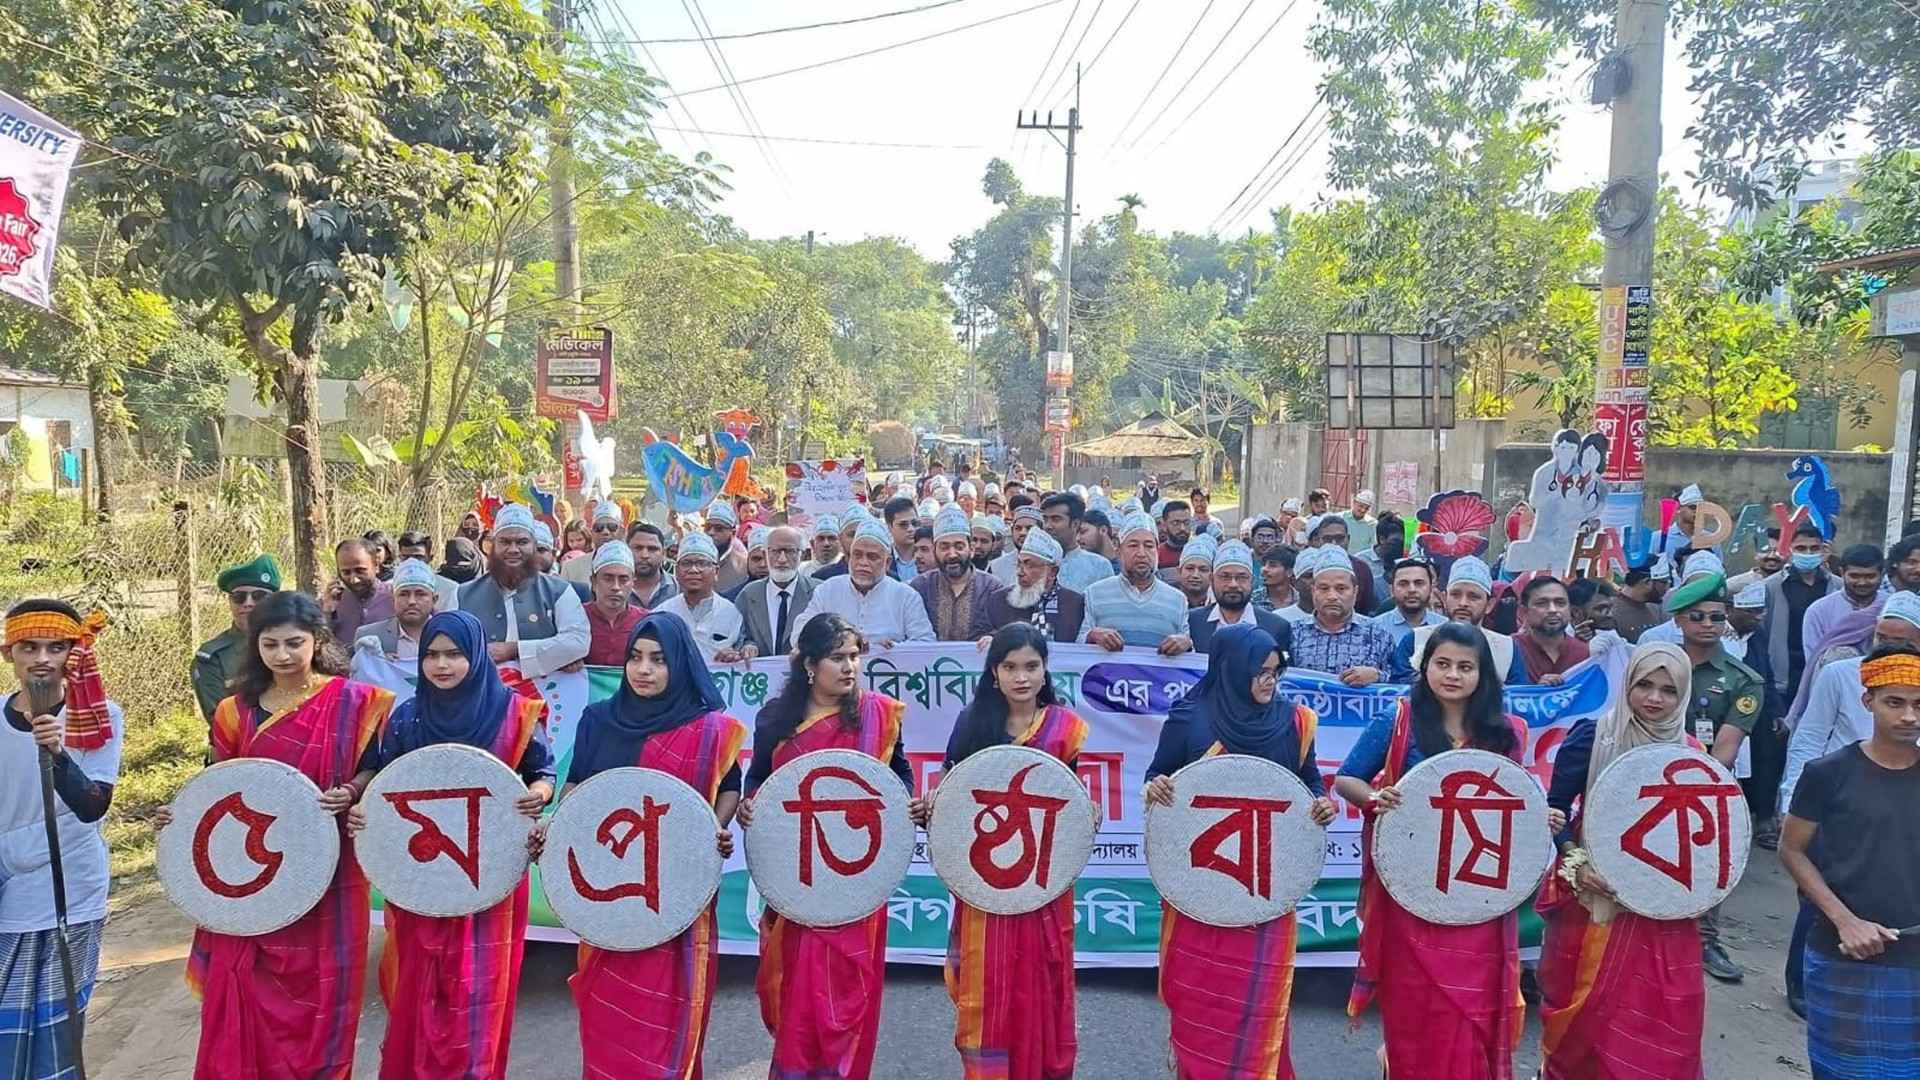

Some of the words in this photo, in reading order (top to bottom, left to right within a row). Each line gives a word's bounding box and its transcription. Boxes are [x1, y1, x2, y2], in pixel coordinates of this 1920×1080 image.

[0, 241, 17, 265] 26
[545, 336, 604, 351] মেডিকেল
[1105, 679, 1151, 708] এর
[192, 791, 284, 898] ৫
[382, 786, 493, 891] ম
[567, 794, 671, 915] প্র
[783, 765, 888, 887] তি
[1188, 794, 1293, 901] বা
[1620, 757, 1744, 893] কী
